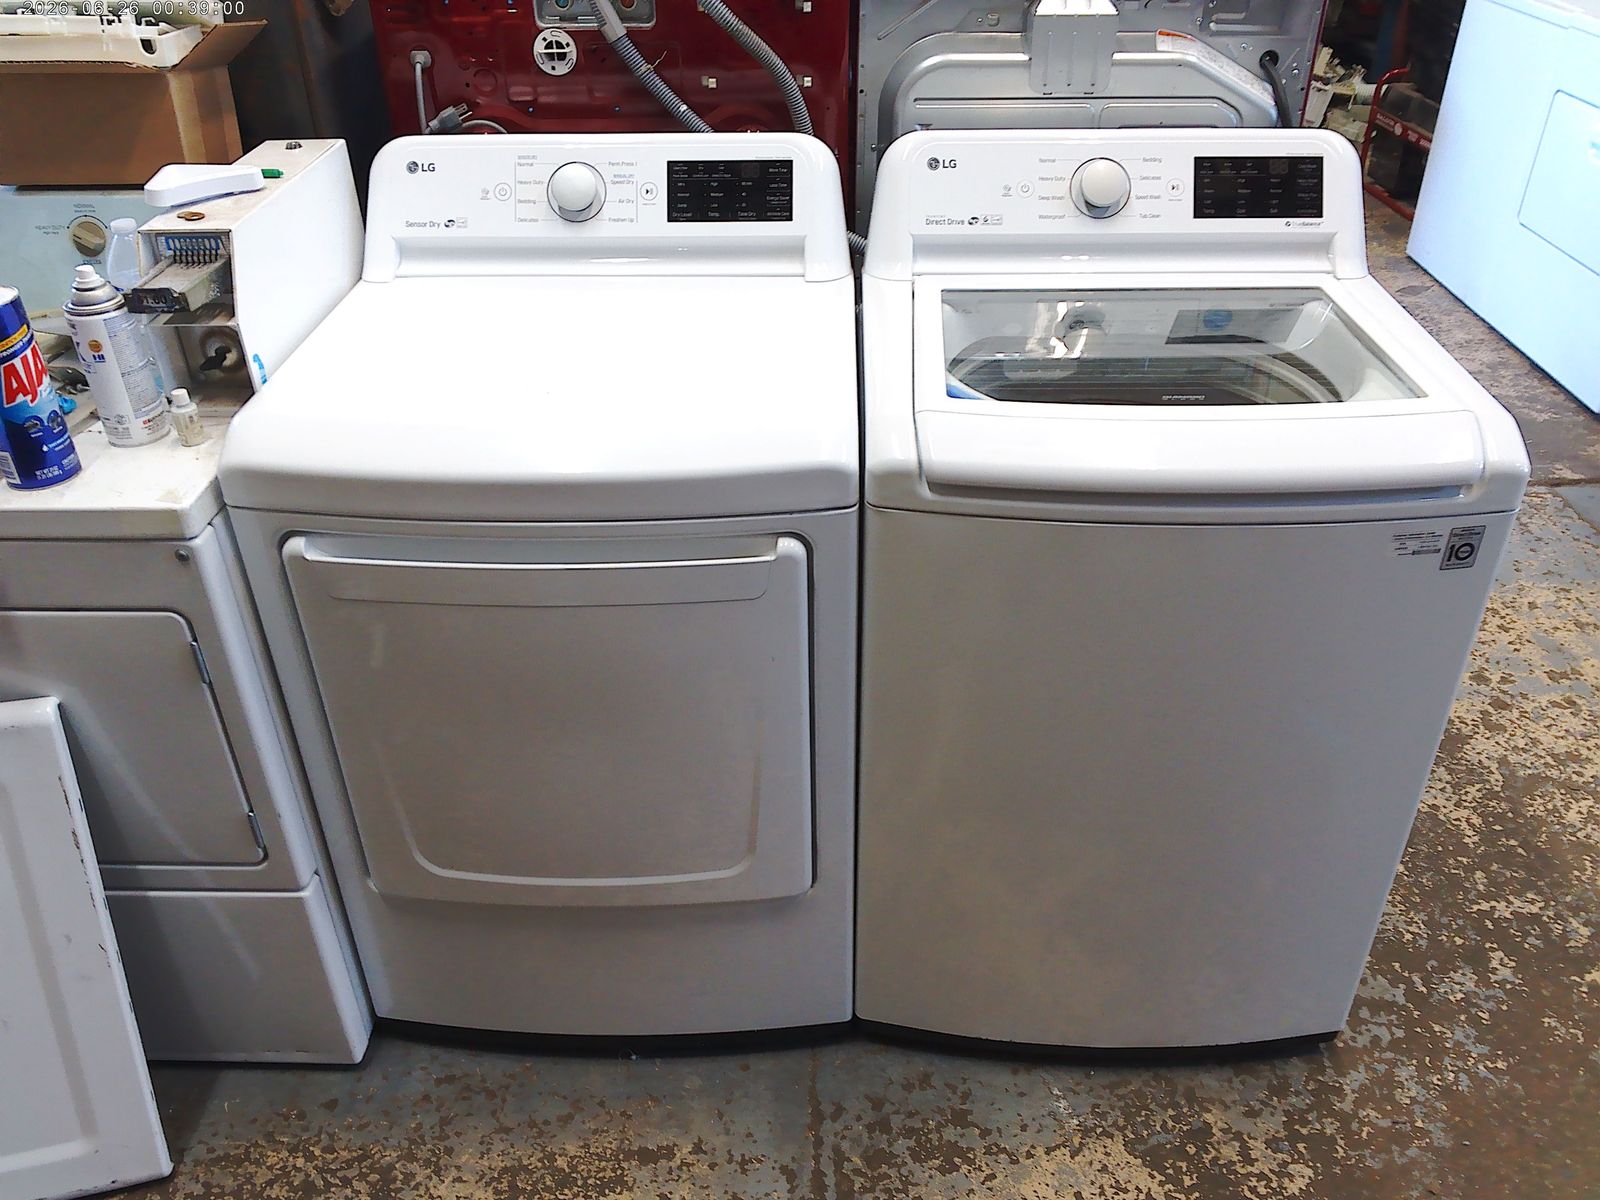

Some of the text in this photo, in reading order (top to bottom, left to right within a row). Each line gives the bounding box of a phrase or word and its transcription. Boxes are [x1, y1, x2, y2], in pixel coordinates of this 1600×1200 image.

[421, 162, 436, 173] LG
[942, 159, 957, 169] LG
[405, 220, 441, 229] Sensor Dry
[925, 218, 965, 226] Direct Drive
[3, 344, 48, 405] AJA
